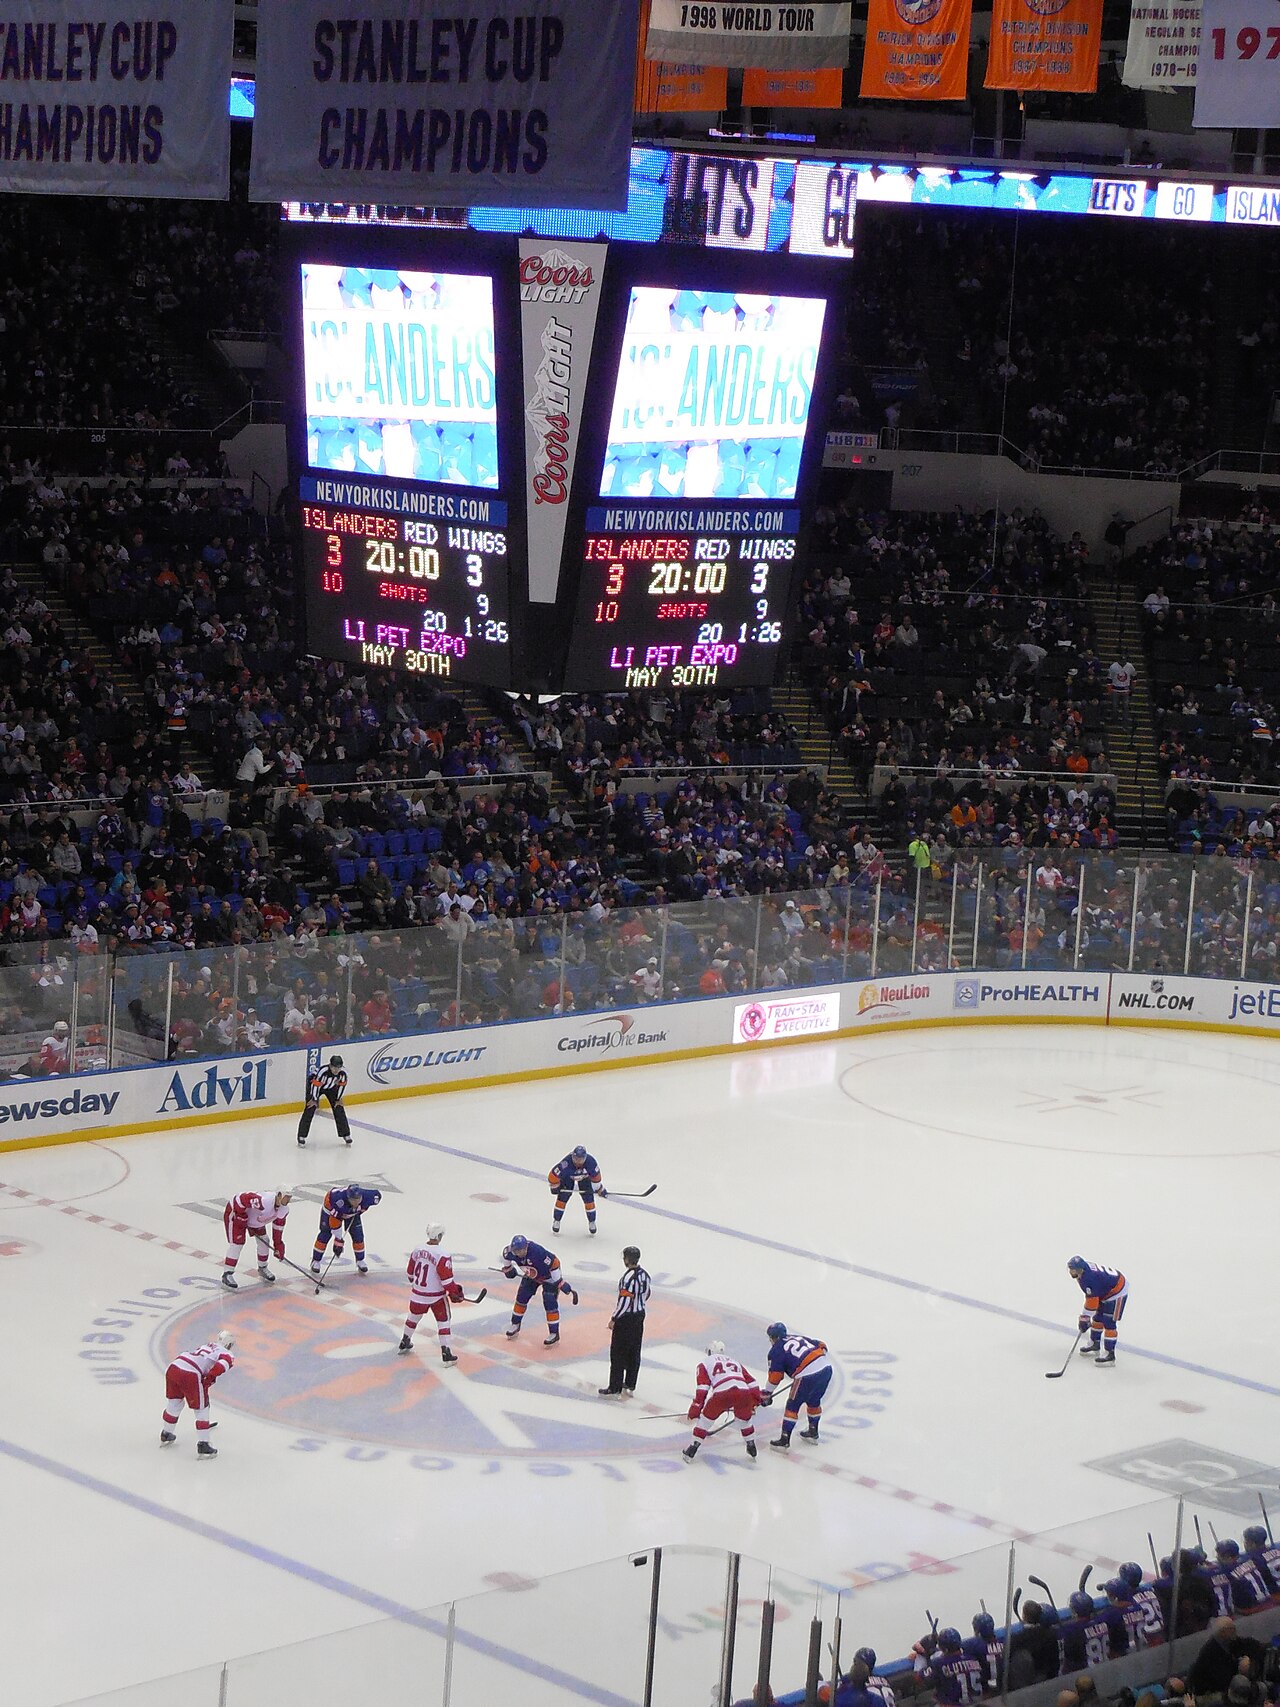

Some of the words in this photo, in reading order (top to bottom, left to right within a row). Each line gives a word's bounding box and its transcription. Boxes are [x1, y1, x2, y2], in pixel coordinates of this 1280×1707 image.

[680, 5, 717, 30] 1998
[722, 7, 772, 31] WORLD
[778, 8, 815, 32] TOUR
[1144, 27, 1185, 38] REGULAR
[110, 20, 177, 82] CUP
[313, 17, 479, 83] STANLEY
[485, 18, 565, 82] CUP
[1012, 41, 1073, 55] CHAMPIONS
[318, 107, 549, 175] CHAMPIONS
[1091, 181, 1137, 212] LET'S
[1173, 186, 1195, 217] GO
[520, 256, 595, 288] Coors
[520, 285, 590, 304] LIGHT
[548, 316, 573, 414] LIGHT
[533, 412, 570, 506] Coors
[316, 480, 490, 523] NEWYORKISLANDERS.COM
[303, 507, 398, 539] ISLANDERS
[404, 520, 439, 545] RED
[448, 527, 507, 555] WINGS
[604, 510, 784, 532] NEWYORKISLANDERS.COM
[326, 534, 342, 566] 3
[365, 540, 440, 580] 20:00
[466, 554, 483, 587] 3
[585, 539, 690, 560] ISLANDERS
[694, 539, 731, 560] RED
[739, 539, 797, 560] WINGS
[605, 563, 625, 595] 3
[648, 562, 727, 594] 20:00
[750, 563, 769, 594] 3
[322, 571, 344, 593] 10
[379, 581, 429, 603] SHOTS
[476, 593, 489, 616] 9
[595, 601, 619, 622] 10
[657, 603, 708, 620] SHOTS
[756, 598, 769, 620] 9
[343, 618, 366, 642] LI
[376, 623, 410, 648] PET
[420, 631, 467, 658] EXPO
[423, 609, 448, 633] 20
[463, 616, 509, 643] 1:26
[697, 622, 723, 644] 20
[737, 621, 782, 643] 1:26
[361, 642, 395, 667] MAY
[405, 649, 451, 676] 30TH
[610, 646, 635, 668] LI
[645, 645, 682, 666] PET
[690, 643, 738, 665] EXPO
[625, 666, 662, 688] MAY
[671, 665, 718, 686] 30TH
[879, 984, 930, 1002] NeuLion
[980, 985, 1100, 1002] ProHEALTH
[1118, 992, 1195, 1011] NHL.COM
[637, 1030, 668, 1045] Bank
[773, 1016, 831, 1034] EXECUTIVE
[424, 1046, 488, 1068] LIGHT
[155, 1058, 268, 1114] Advil
[414, 1261, 430, 1289] 41
